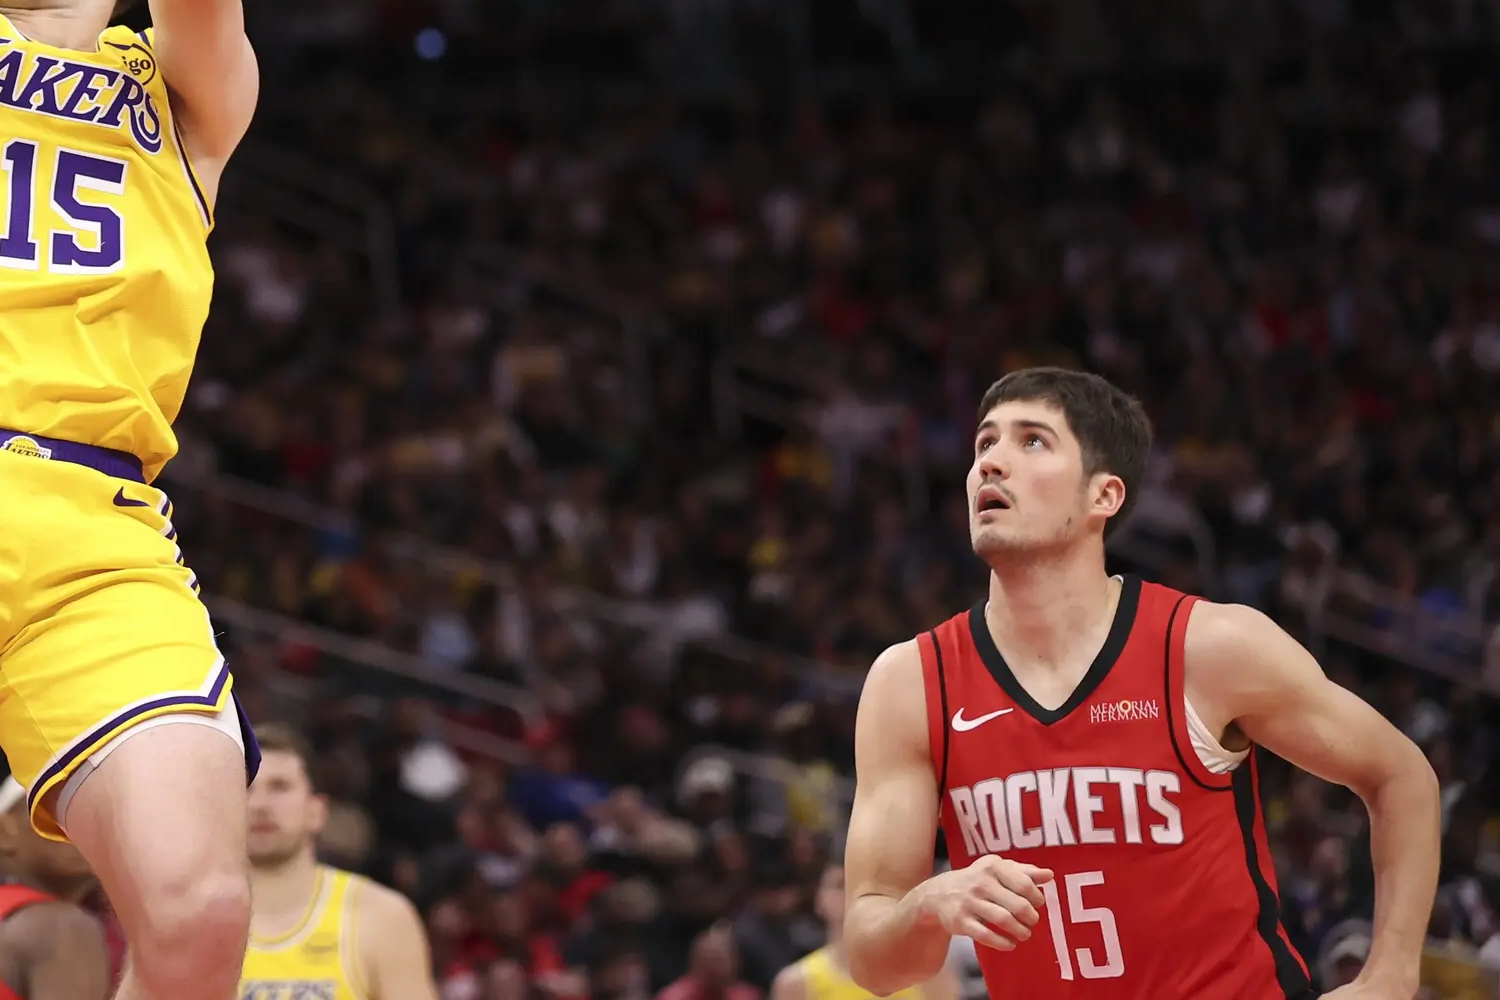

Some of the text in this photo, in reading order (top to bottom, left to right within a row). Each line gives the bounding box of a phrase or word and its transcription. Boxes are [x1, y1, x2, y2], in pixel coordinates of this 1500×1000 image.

[1090, 699, 1158, 714] MEMORIAL
[1090, 708, 1159, 723] HERMANN
[949, 766, 1184, 857] ROCKETS
[1038, 871, 1125, 980] 15
